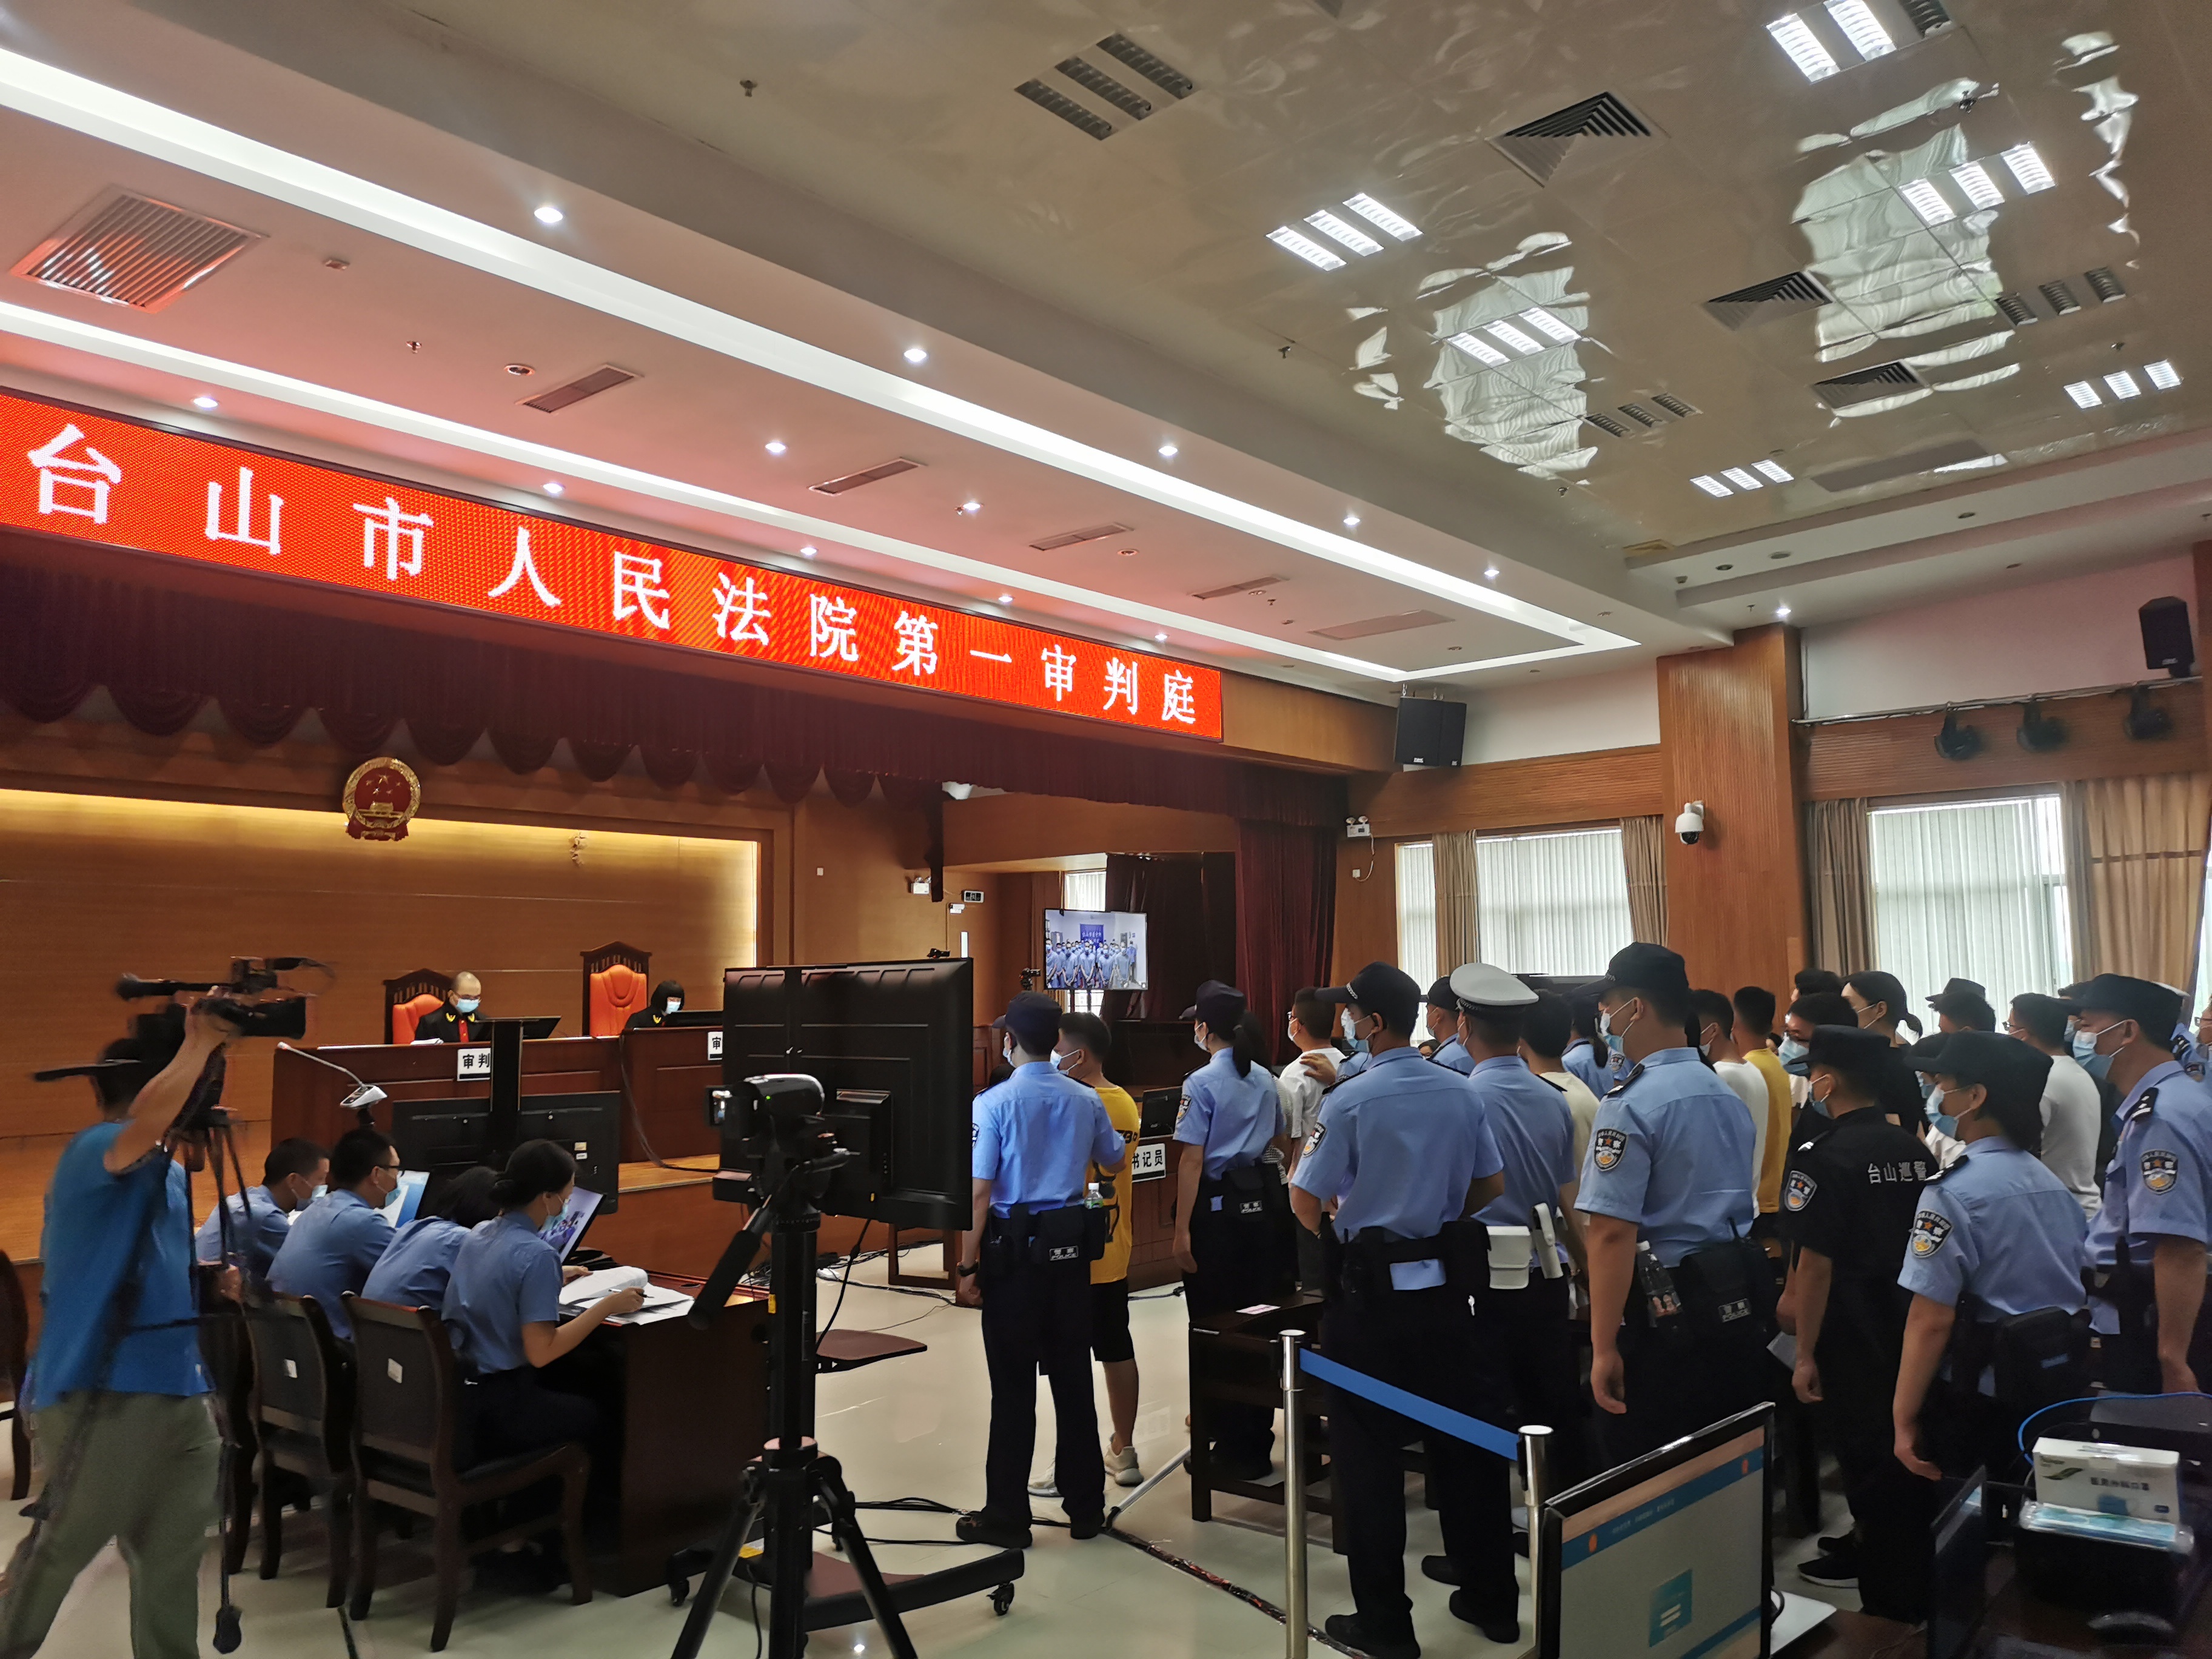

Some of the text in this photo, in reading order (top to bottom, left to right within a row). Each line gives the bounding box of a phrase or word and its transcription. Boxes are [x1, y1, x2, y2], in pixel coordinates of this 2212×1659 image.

[27, 423, 1196, 724] 台山市人民法院第一审判庭
[712, 1036, 722, 1050] 审
[463, 1053, 490, 1069] 审判
[1131, 1149, 1162, 1169] 书记员
